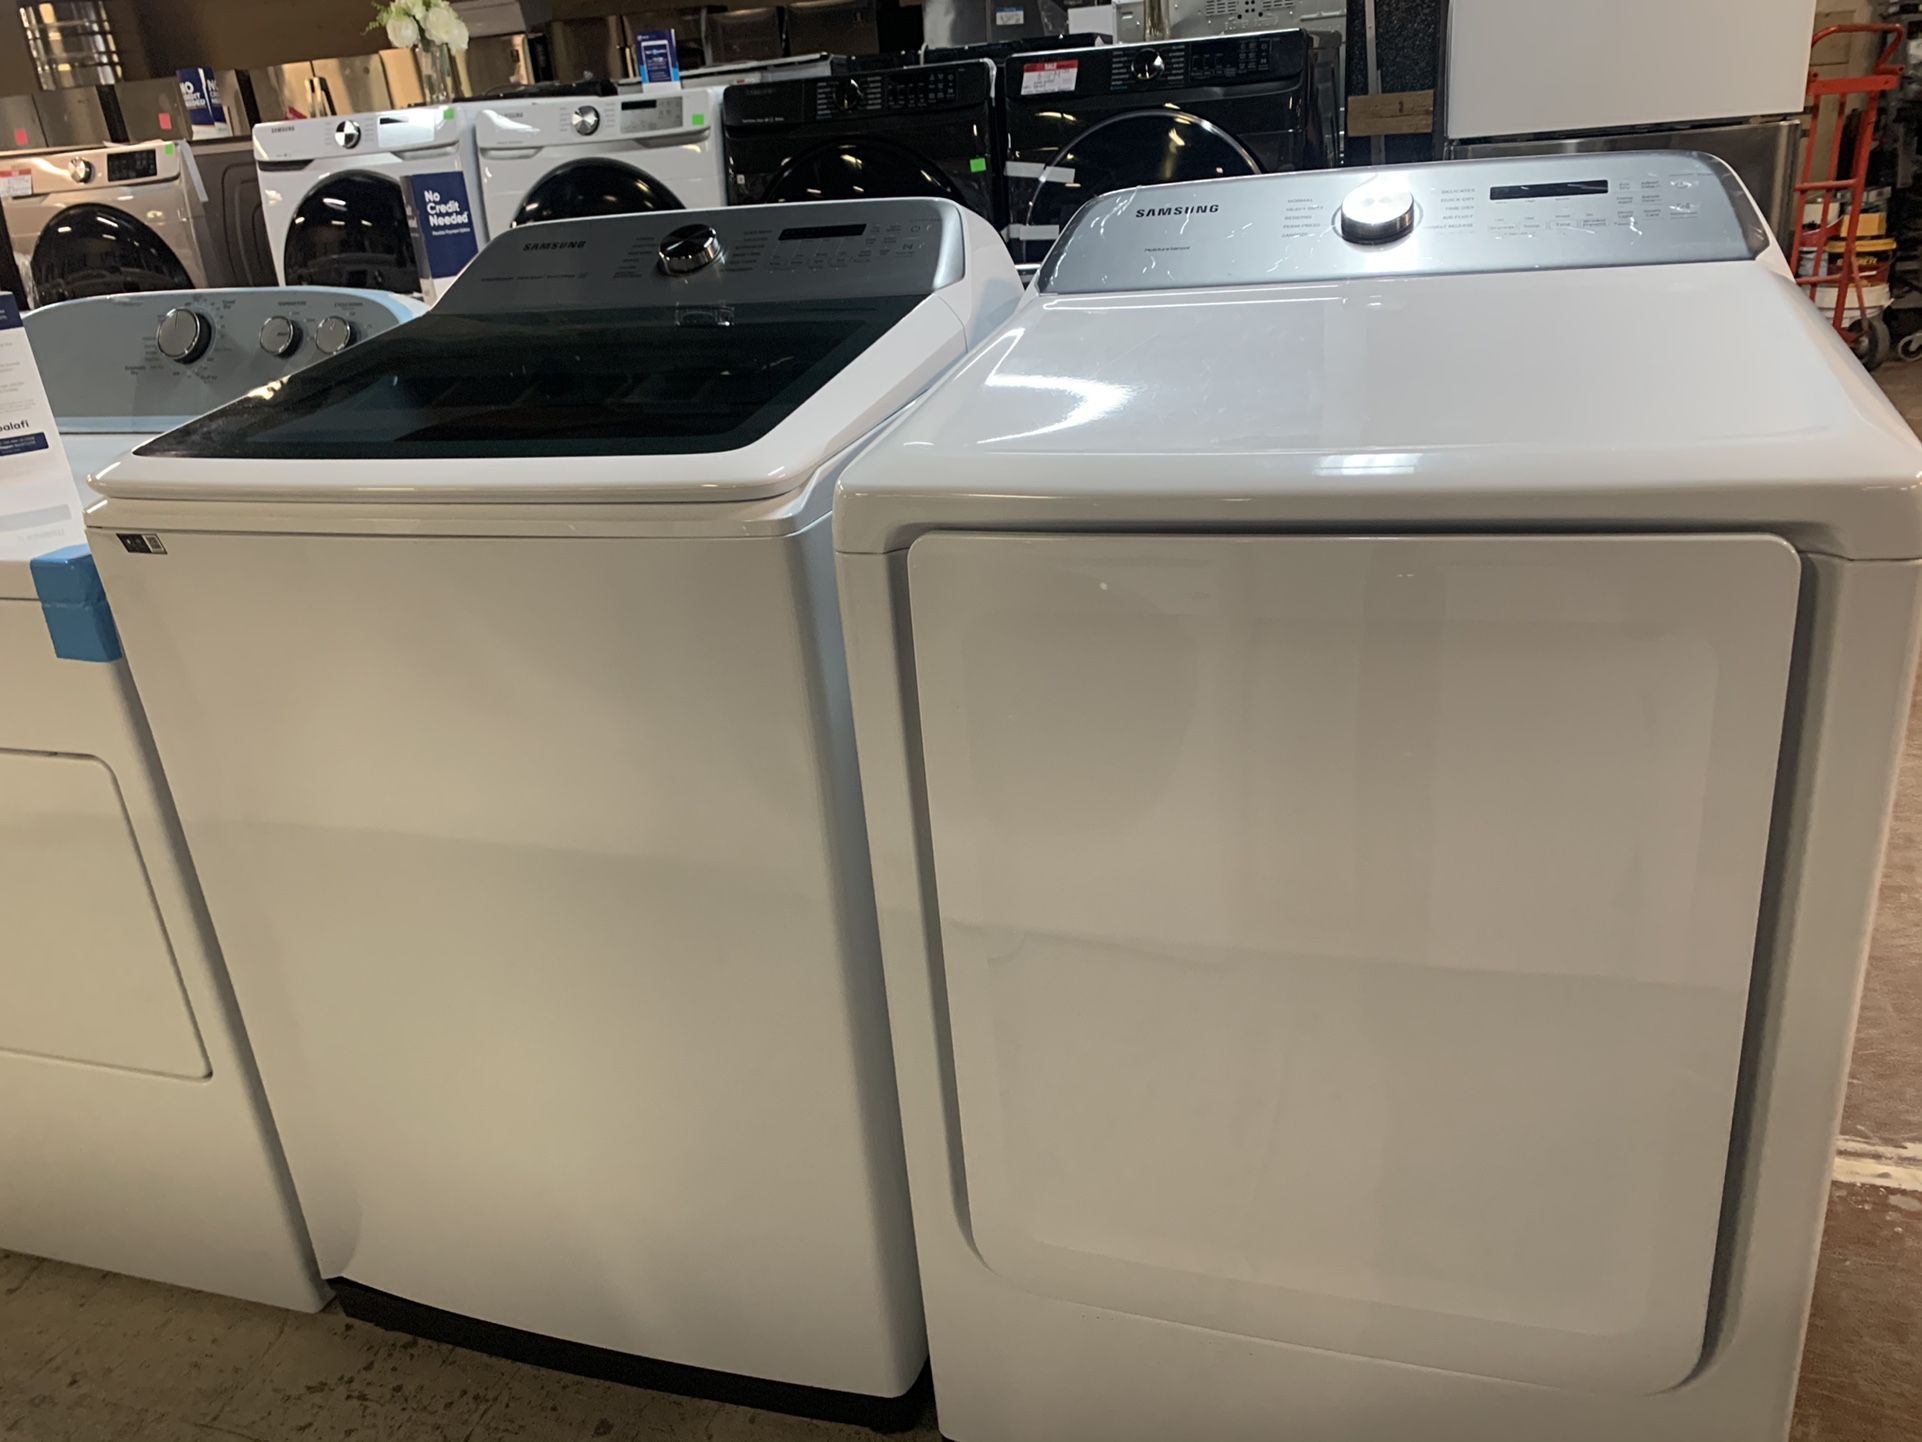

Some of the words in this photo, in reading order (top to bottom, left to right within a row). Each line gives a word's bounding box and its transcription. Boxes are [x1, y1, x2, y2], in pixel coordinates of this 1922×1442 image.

[424, 190, 440, 202] No
[427, 200, 460, 214] Credit
[1135, 204, 1219, 218] SAMSUNG
[428, 211, 469, 227] Needed
[522, 240, 587, 251] SAMSUNG
